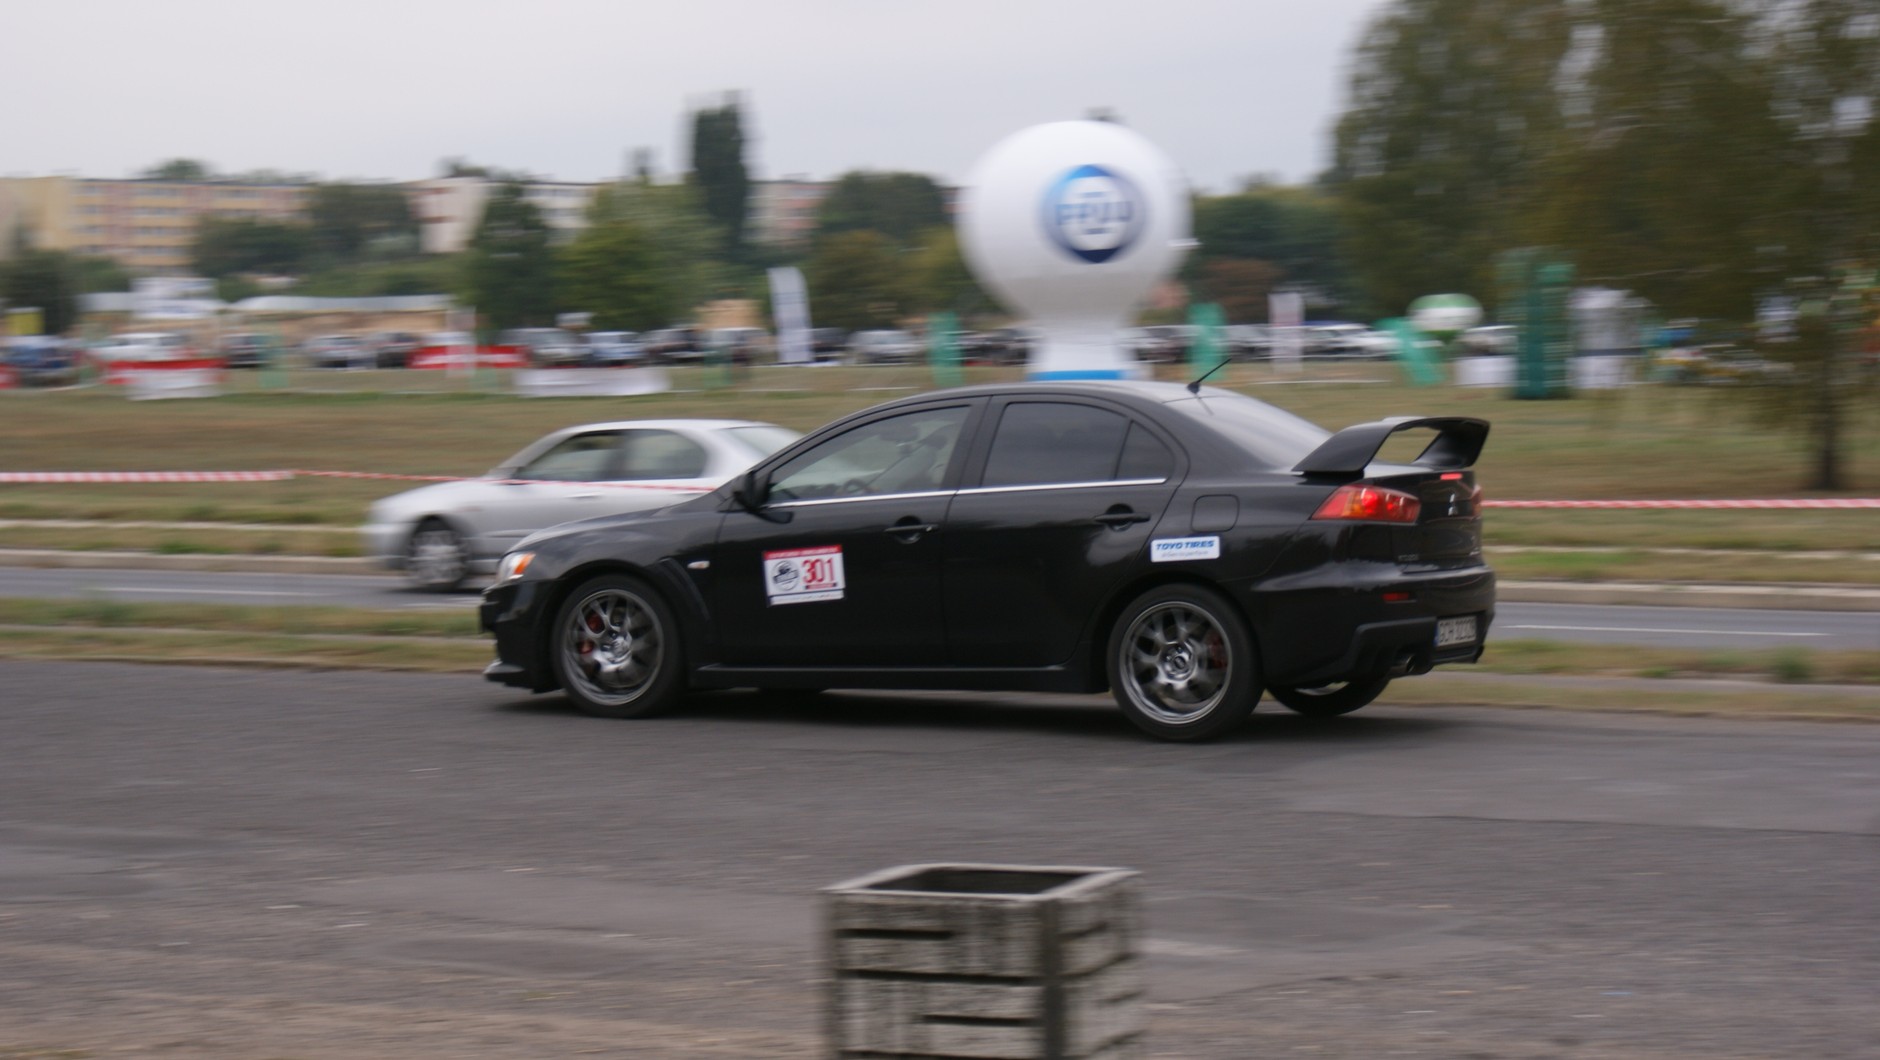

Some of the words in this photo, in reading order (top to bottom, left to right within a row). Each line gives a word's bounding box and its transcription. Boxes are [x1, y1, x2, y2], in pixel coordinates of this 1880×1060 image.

[1156, 542, 1184, 551] TOYO
[1185, 540, 1215, 549] TIRES
[802, 557, 834, 584] 301
